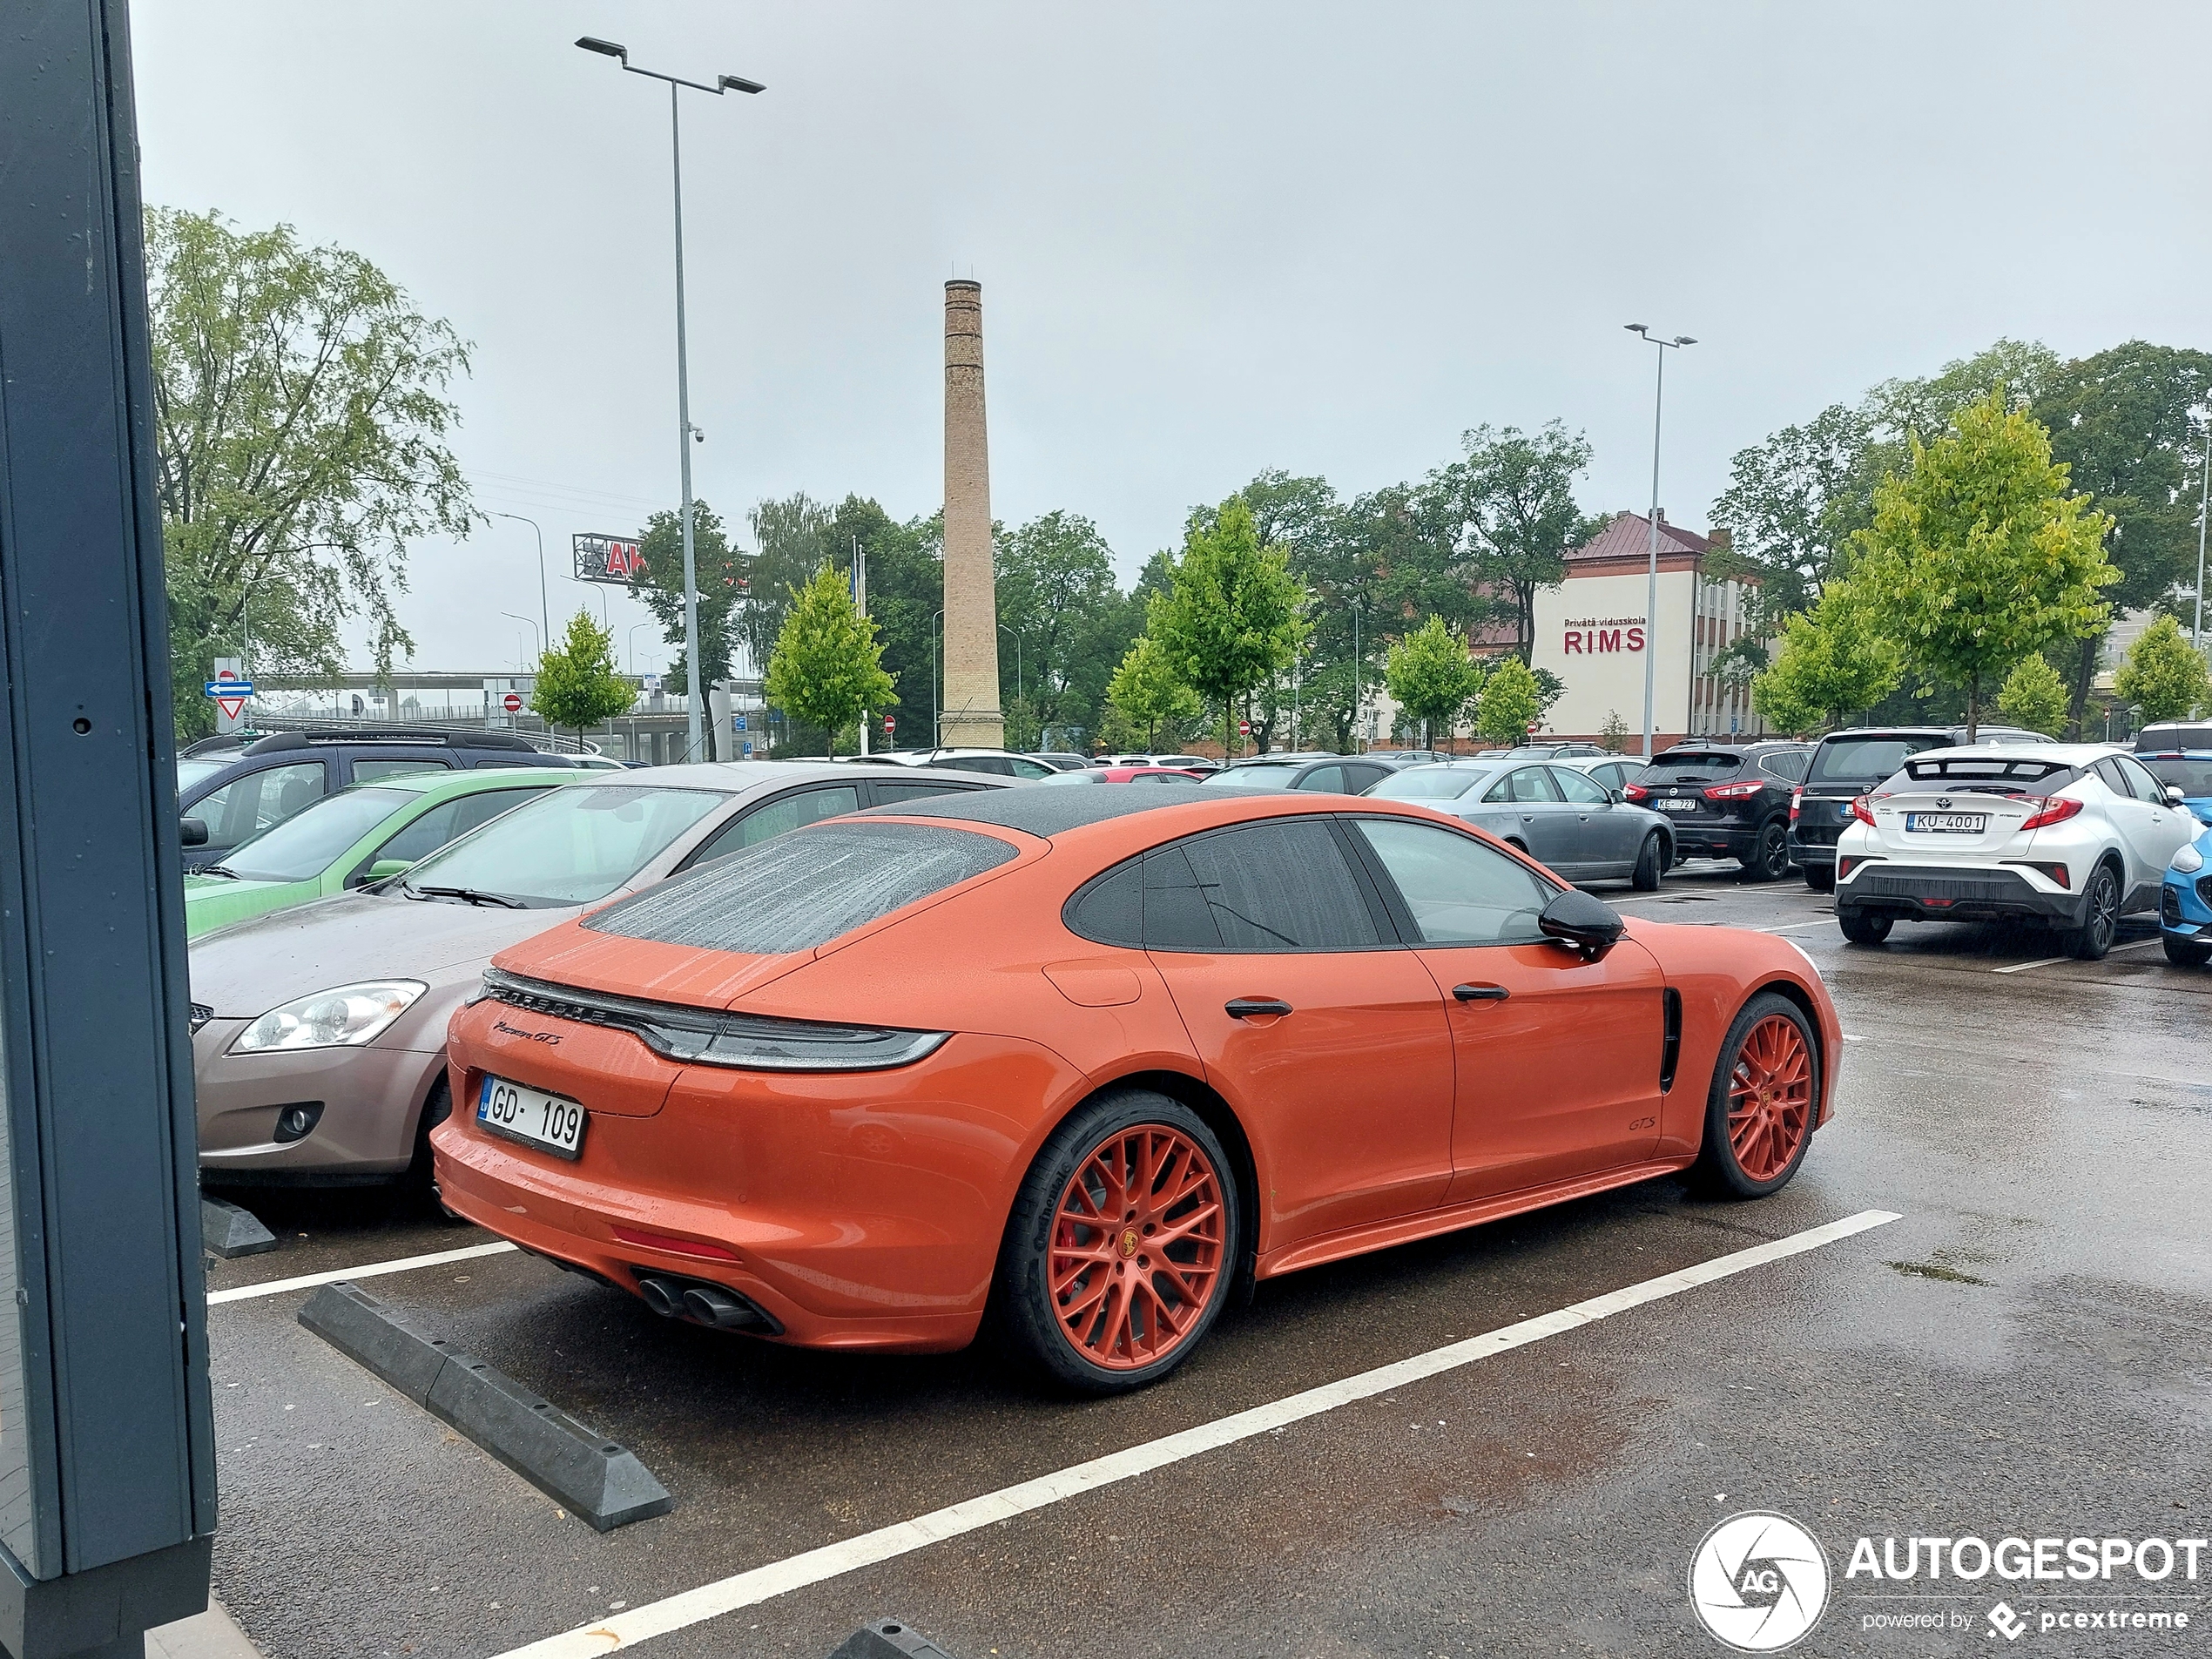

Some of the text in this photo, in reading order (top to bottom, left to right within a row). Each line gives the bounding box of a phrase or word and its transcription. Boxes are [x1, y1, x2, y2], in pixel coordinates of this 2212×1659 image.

[1564, 615, 1646, 627] Privātā vidusskola
[1564, 627, 1645, 655] RIMS
[1679, 799, 1695, 808] 727
[1917, 815, 1981, 828] KU-4001
[533, 1032, 564, 1045] GTS
[480, 1102, 489, 1112] LV
[541, 1100, 578, 1144] 109
[1629, 1116, 1656, 1130] GTS
